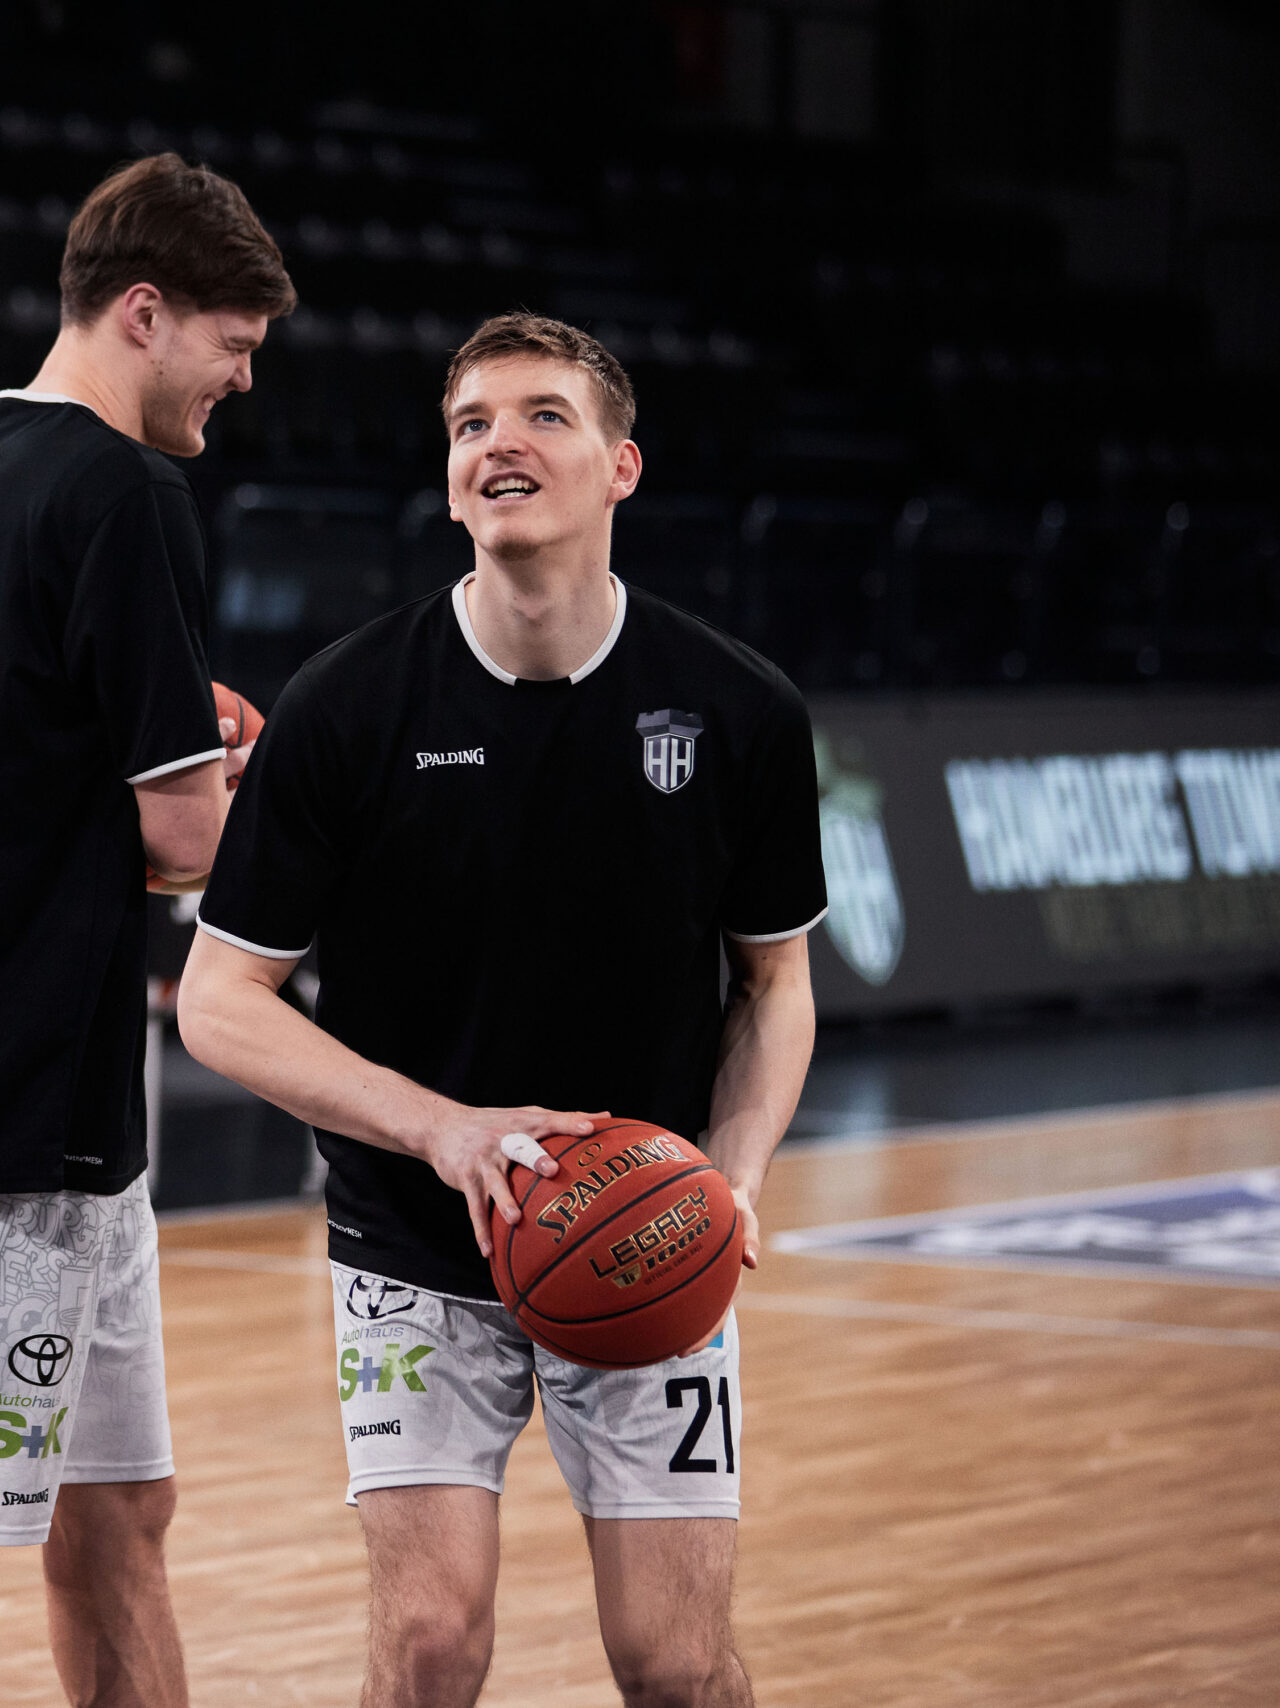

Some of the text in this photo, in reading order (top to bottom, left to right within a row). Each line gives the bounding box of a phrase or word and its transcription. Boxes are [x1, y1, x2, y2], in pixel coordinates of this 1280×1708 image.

[416, 746, 486, 769] SPALDING
[646, 737, 692, 788] HH
[536, 1135, 691, 1244] SPALDING
[588, 1185, 710, 1280] LEGACY
[643, 1216, 711, 1272] 1000
[340, 1325, 406, 1345] Autohaus
[348, 1418, 402, 1442] SPALDING
[665, 1375, 735, 1474] 21
[1, 1488, 49, 1507] SPALDING
